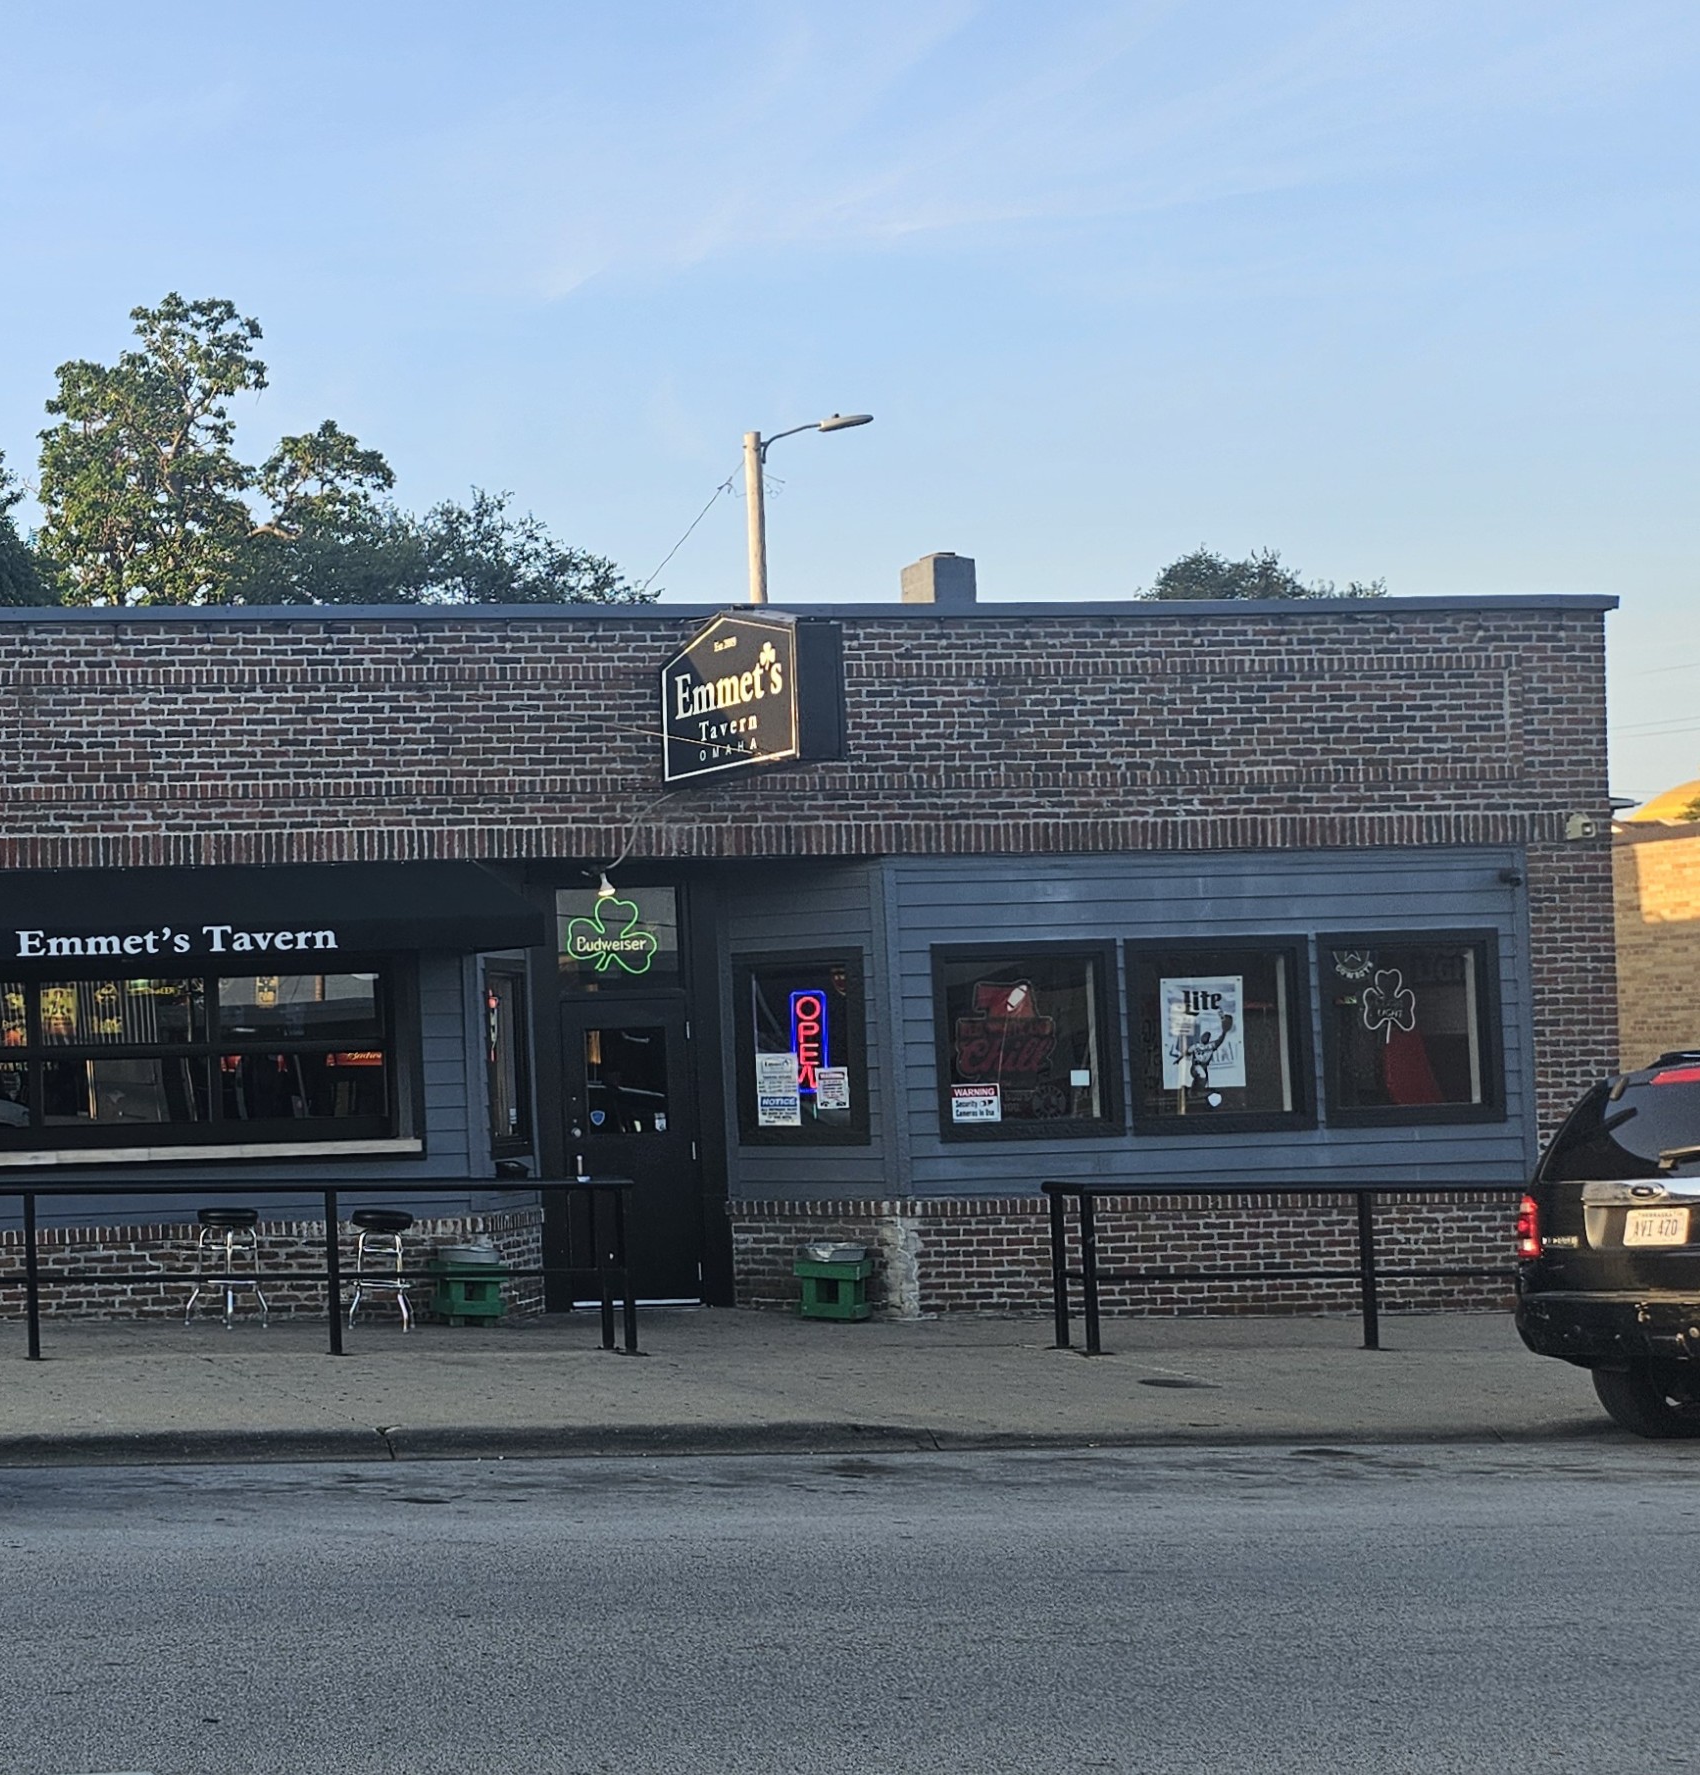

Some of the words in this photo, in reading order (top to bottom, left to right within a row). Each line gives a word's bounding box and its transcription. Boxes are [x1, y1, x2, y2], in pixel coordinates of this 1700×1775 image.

[675, 662, 783, 720] Emmet's
[699, 715, 758, 742] Tavern
[700, 737, 758, 762] OMAHA
[15, 927, 190, 957] Emmet's
[202, 925, 338, 952] Tavern
[576, 936, 647, 951] Budweiser
[1182, 990, 1223, 1016] Lite
[796, 996, 821, 1089] OPEN
[960, 1037, 1054, 1074] Chill
[762, 1098, 796, 1106] NOTICE
[953, 1088, 995, 1097] WARNING
[955, 1100, 978, 1108] Security
[956, 1109, 978, 1117] Cameras
